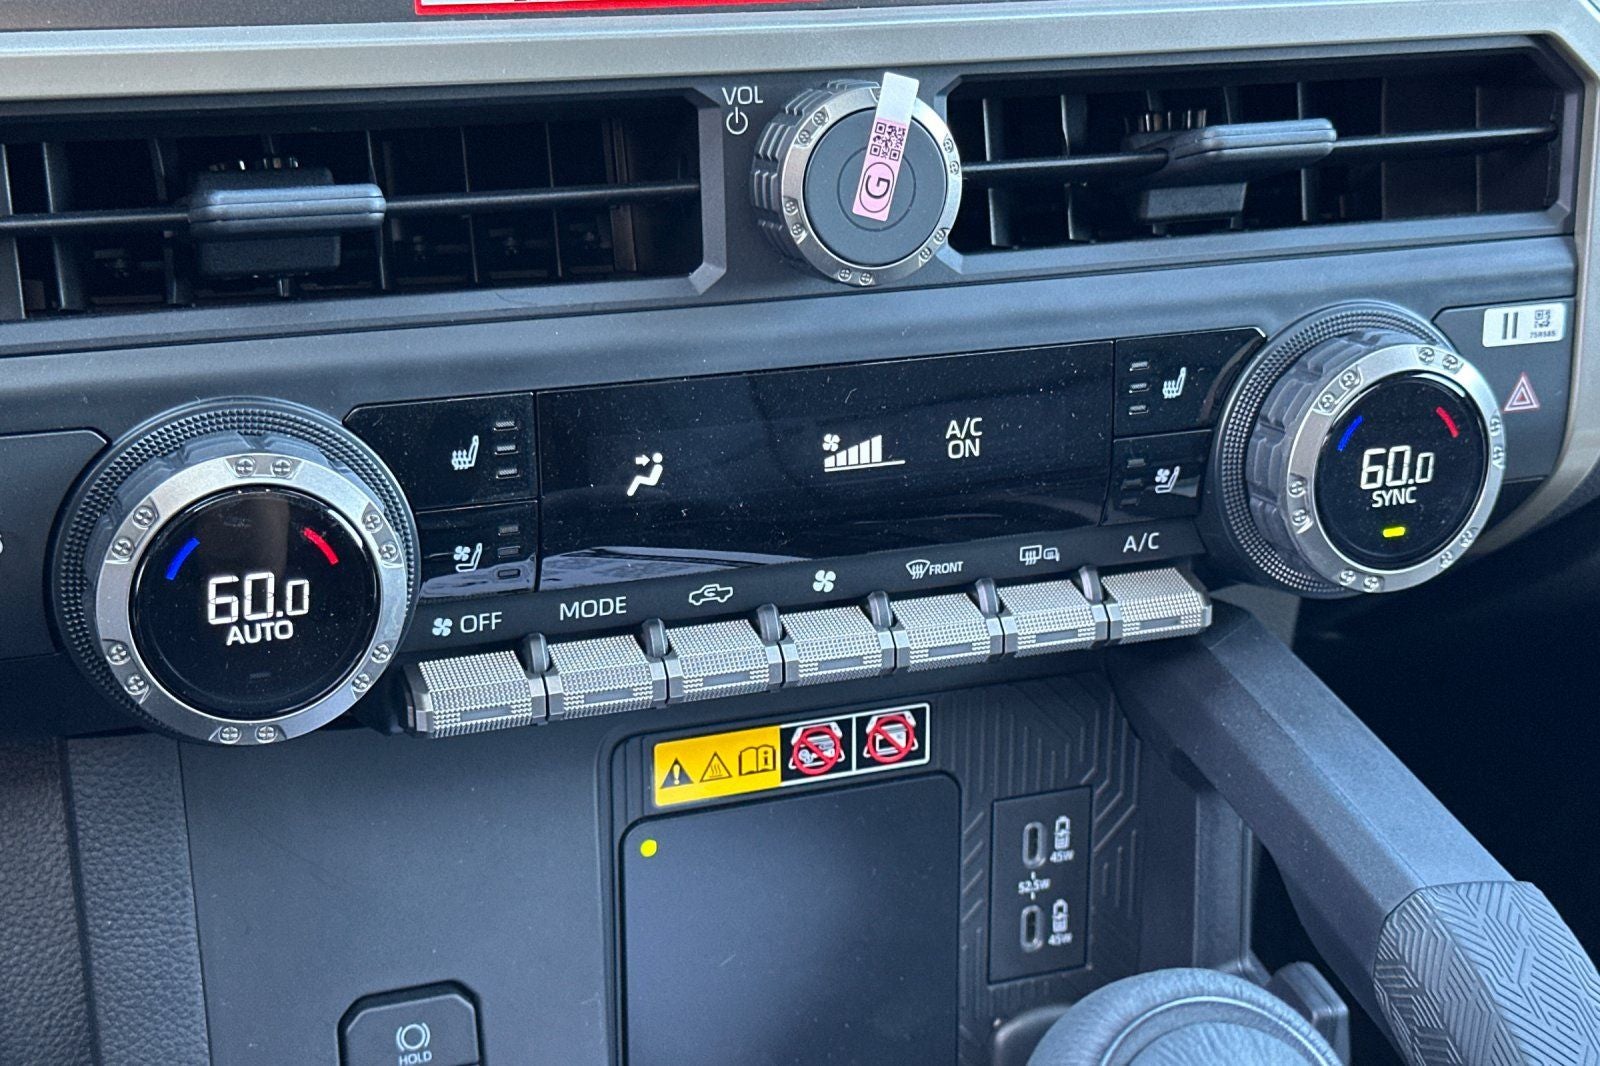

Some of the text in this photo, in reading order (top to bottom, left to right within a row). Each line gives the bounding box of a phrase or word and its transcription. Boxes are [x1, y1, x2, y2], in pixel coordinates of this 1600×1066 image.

[721, 85, 763, 105] VOL
[865, 174, 890, 200] G
[945, 417, 983, 439] A/C
[947, 438, 981, 459] ON
[1360, 445, 1434, 490] 60.0
[1371, 486, 1417, 508] SYNC
[1122, 532, 1160, 553] A/C
[928, 561, 964, 576] FRONT
[207, 571, 310, 625] 60.0
[559, 596, 627, 621] MODE
[226, 619, 294, 646] AUTO
[460, 611, 503, 633] OFF
[1050, 849, 1075, 863] 45W
[399, 1050, 433, 1066] HOLD
